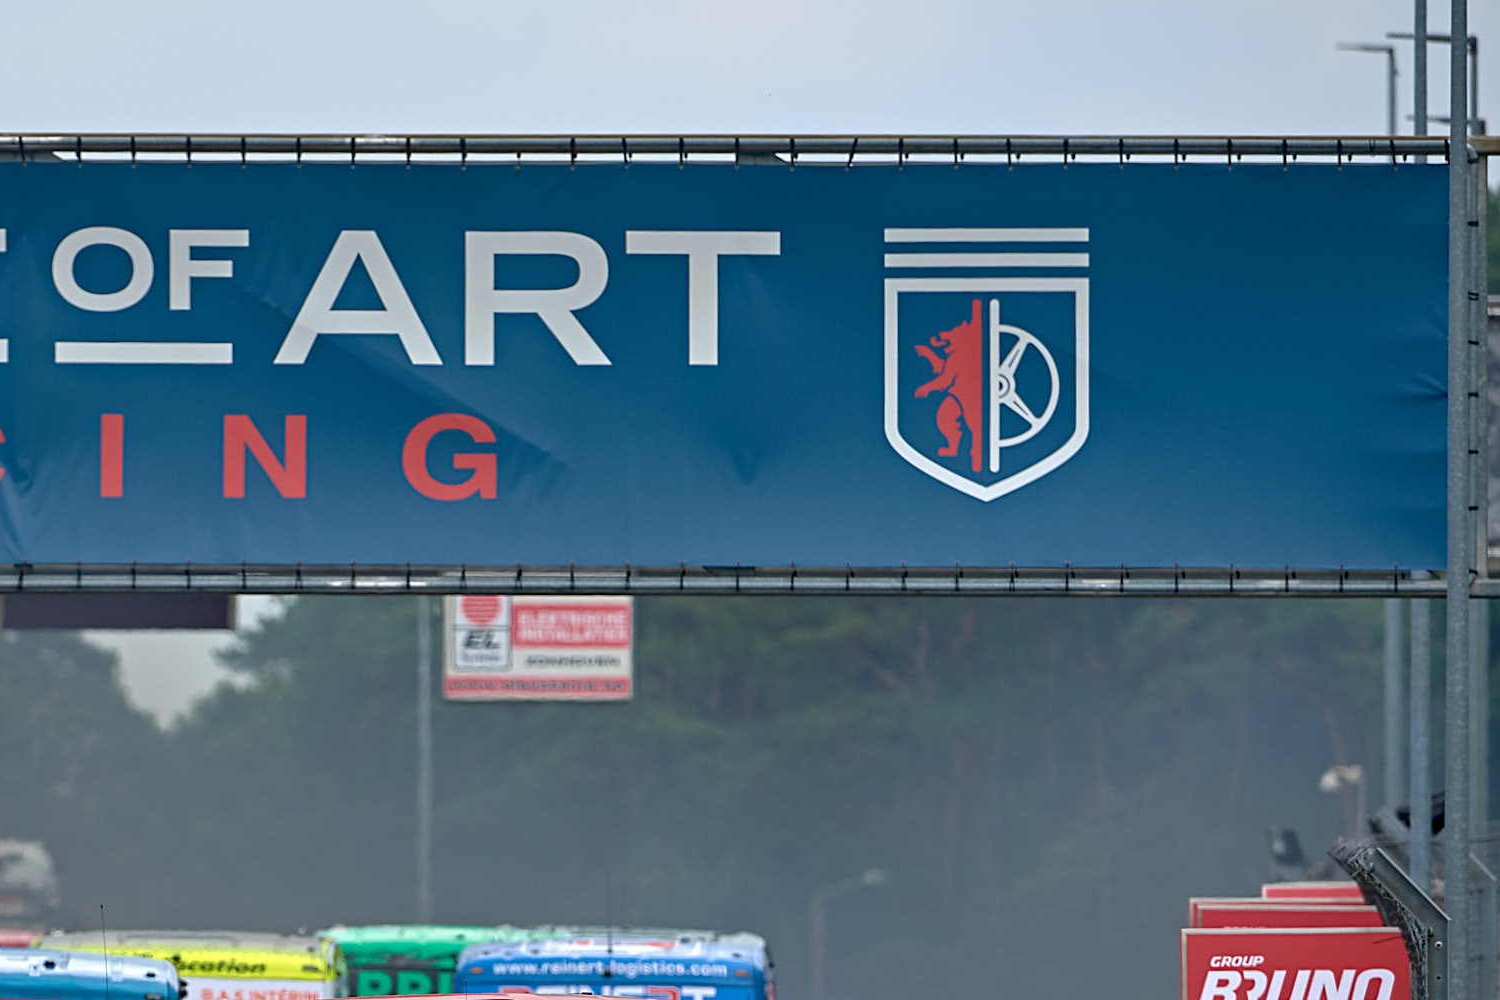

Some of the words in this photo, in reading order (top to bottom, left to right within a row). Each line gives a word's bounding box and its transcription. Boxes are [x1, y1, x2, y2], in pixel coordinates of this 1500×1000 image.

[52, 226, 250, 312] OF
[274, 229, 781, 368] ART
[1210, 955, 1265, 968] GROUP
